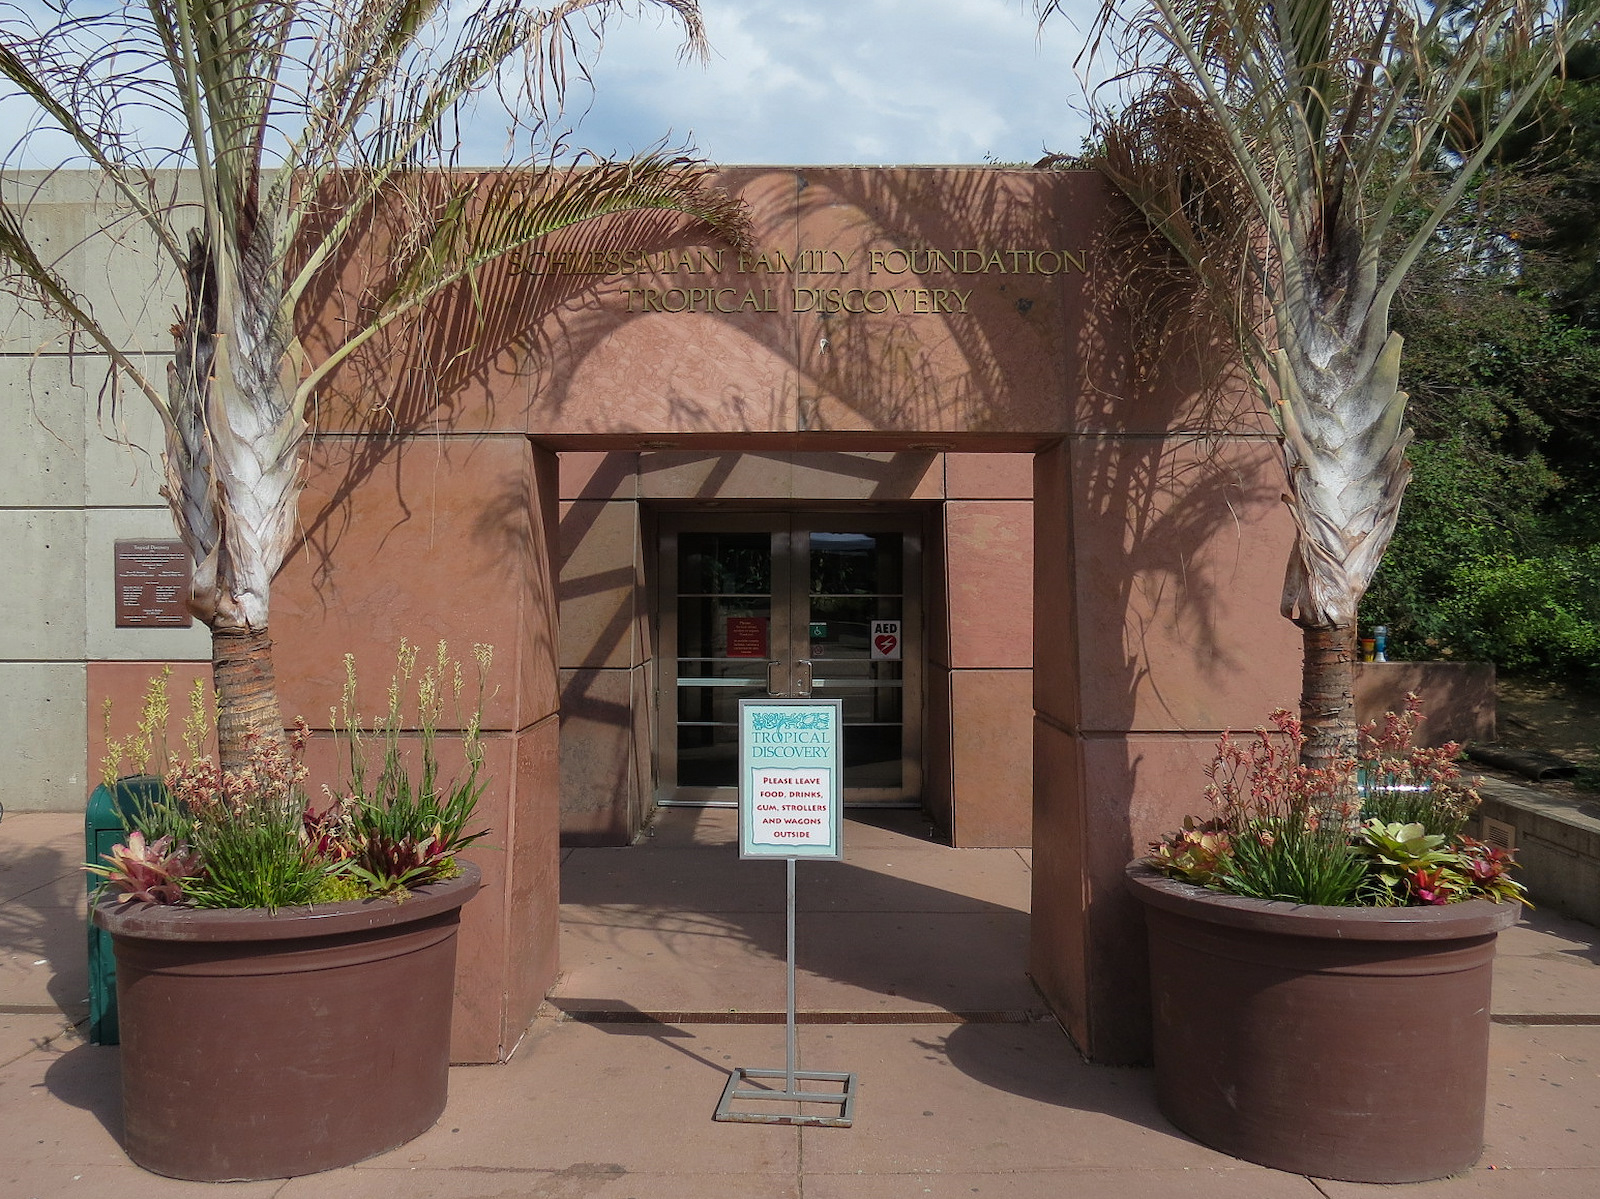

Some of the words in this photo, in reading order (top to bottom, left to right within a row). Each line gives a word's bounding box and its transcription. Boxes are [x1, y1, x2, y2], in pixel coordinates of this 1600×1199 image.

[509, 248, 725, 276] SCHLESSMAN
[736, 249, 857, 275] FAMILY
[868, 248, 1087, 275] FOUNDATION
[620, 287, 778, 314] TROPICAL
[792, 287, 974, 314] DISCOVERY
[874, 623, 897, 634] AED
[752, 731, 830, 744] TROPICAL
[752, 746, 831, 758] DISCOVERY
[763, 776, 793, 785] PLEASE
[795, 777, 821, 785] LEAVE
[782, 804, 827, 812] STROLLERS
[762, 817, 782, 825] AND
